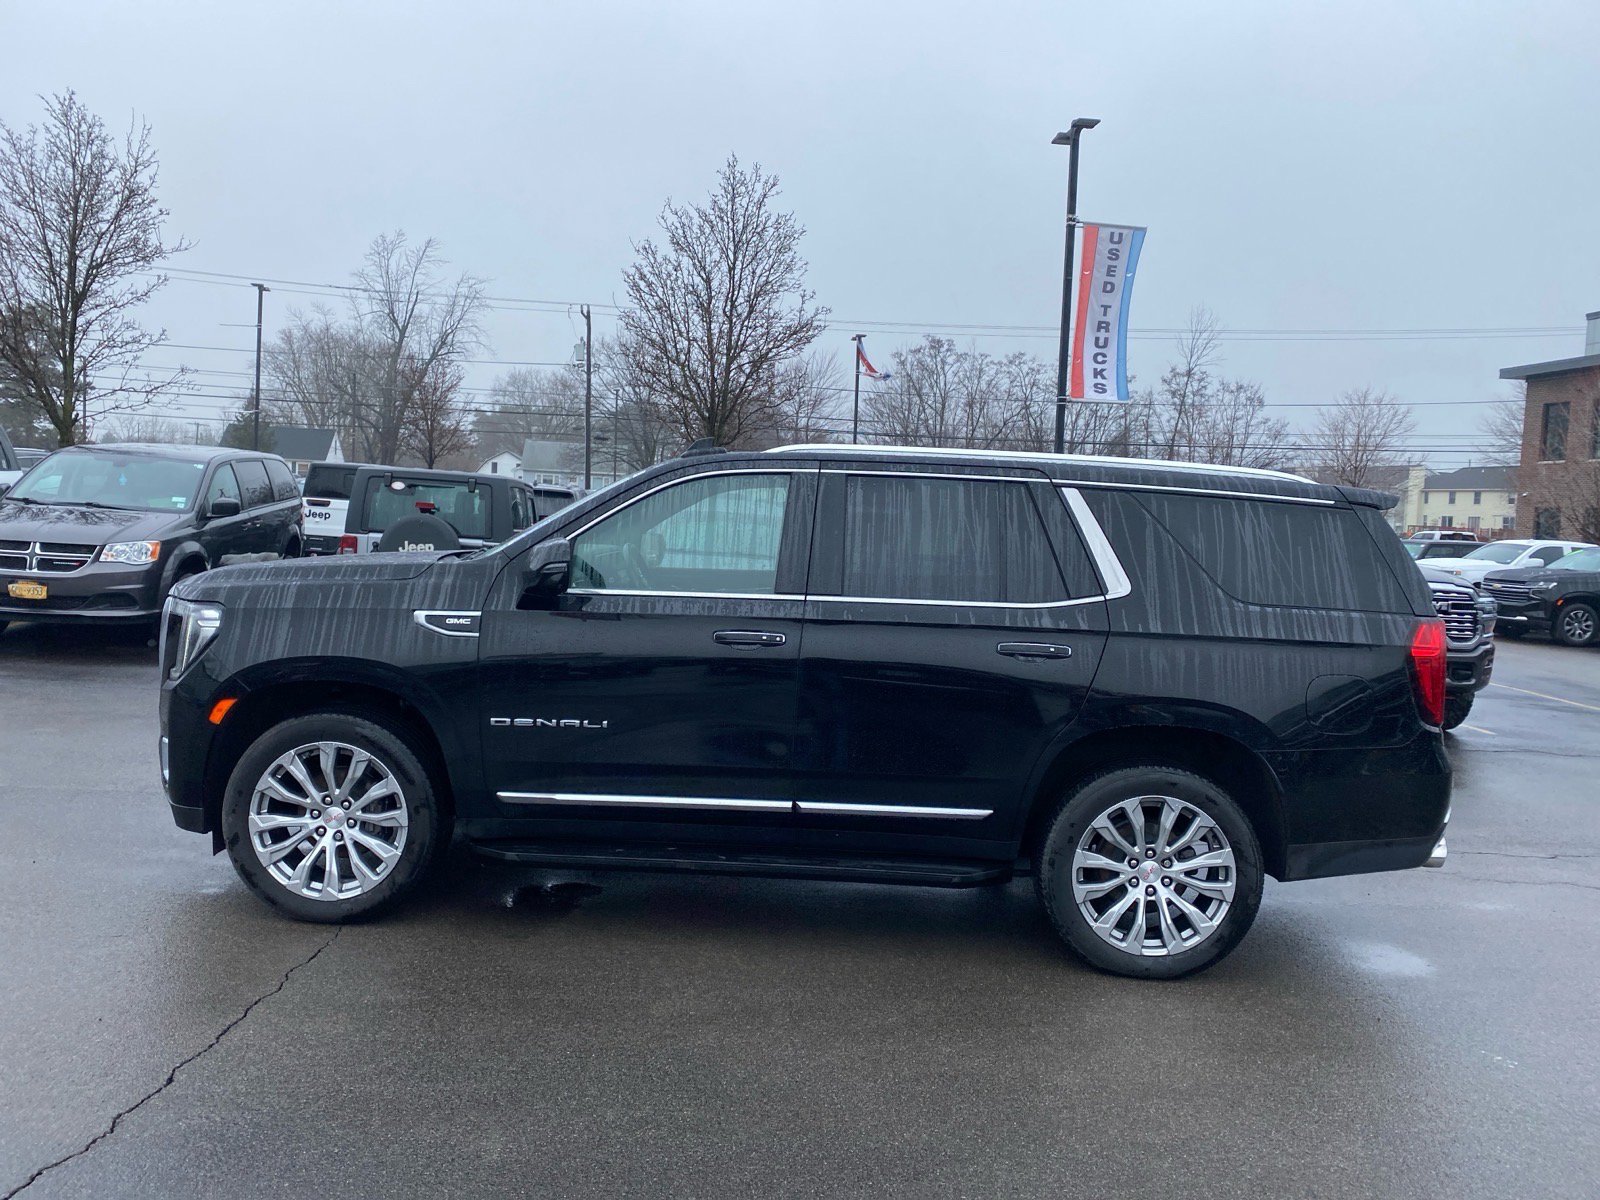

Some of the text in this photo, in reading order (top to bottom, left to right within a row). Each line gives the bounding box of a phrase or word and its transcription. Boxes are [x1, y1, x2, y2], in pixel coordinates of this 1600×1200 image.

[1093, 231, 1123, 394] USED TRUCKS
[304, 509, 331, 521] Jeep
[398, 541, 435, 552] Jeep
[490, 717, 608, 729] DENALI
